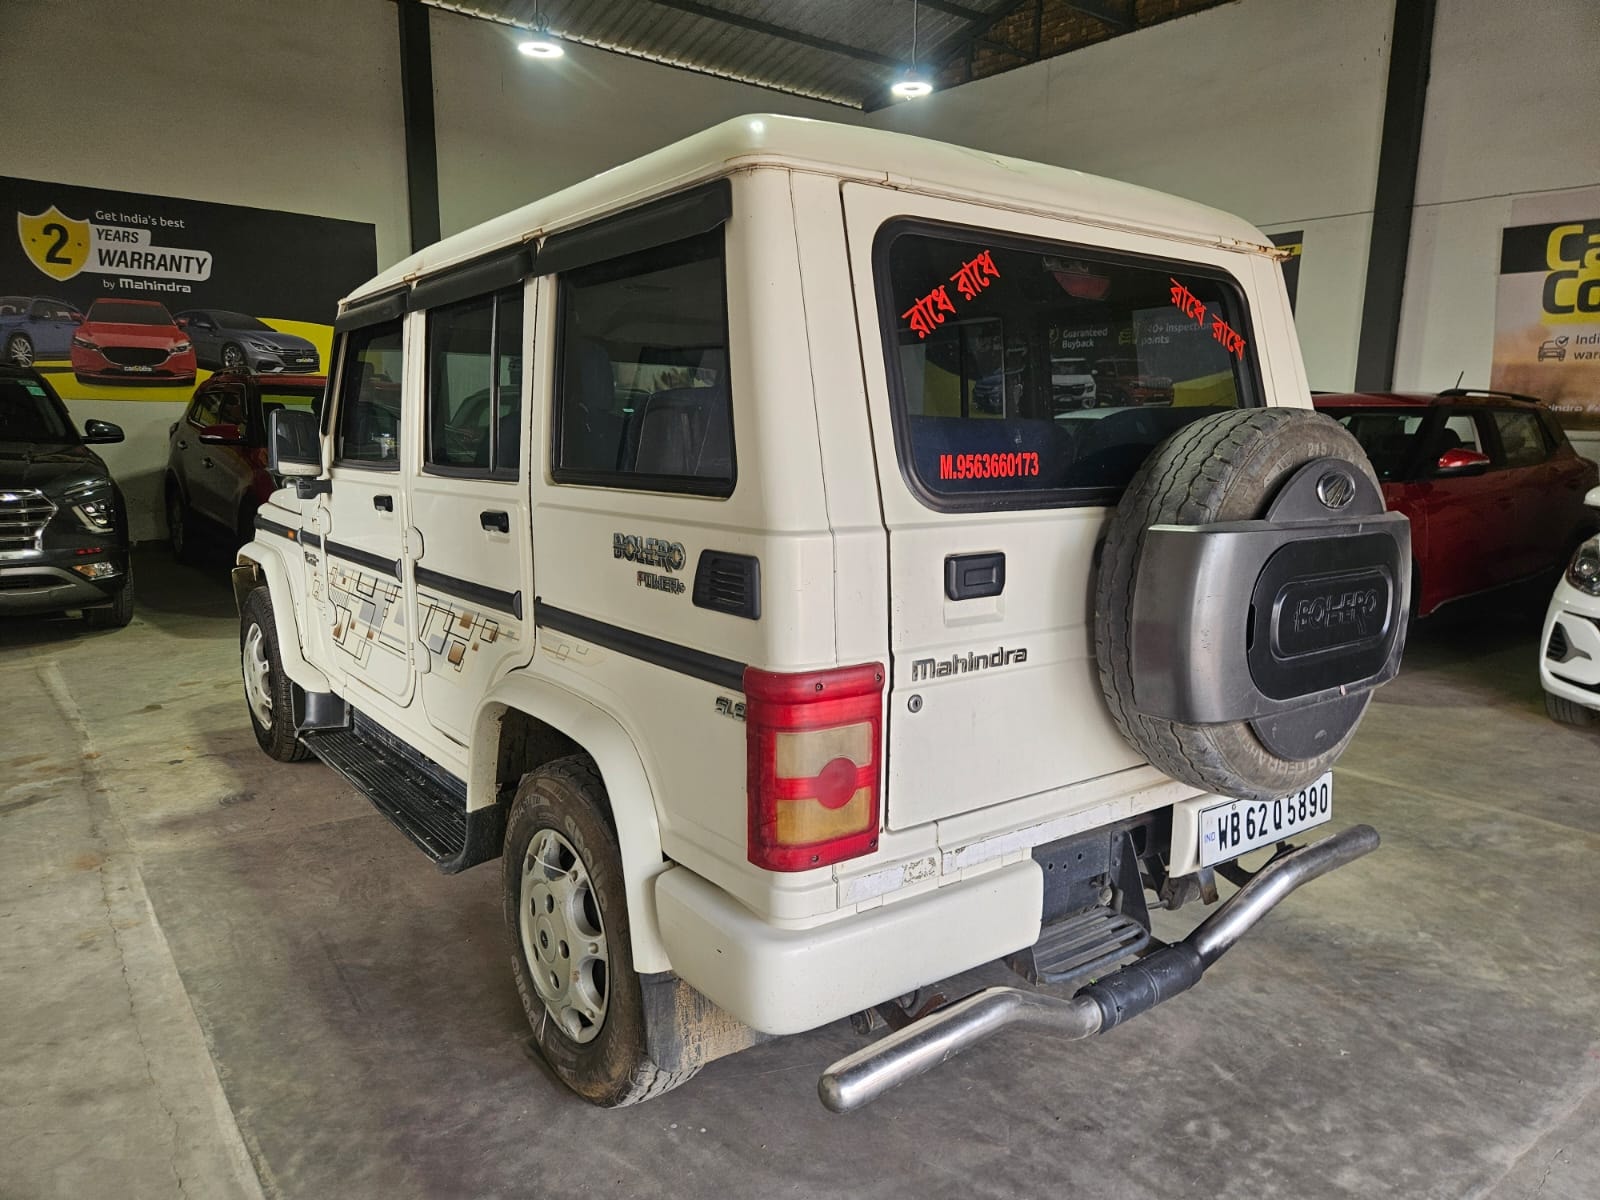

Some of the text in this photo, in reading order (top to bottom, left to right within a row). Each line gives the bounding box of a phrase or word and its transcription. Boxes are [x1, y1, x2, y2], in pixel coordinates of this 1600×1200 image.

[95, 210, 185, 229] Get India's best
[42, 222, 74, 266] 2
[95, 227, 140, 244] YEARS
[97, 248, 209, 275] WARRANTY
[103, 278, 192, 293] by Mahindra
[940, 452, 1040, 479] M.9563660173
[613, 532, 687, 572] BOLERO
[1294, 589, 1377, 634] BOLERO
[911, 647, 1028, 682] Mahindra
